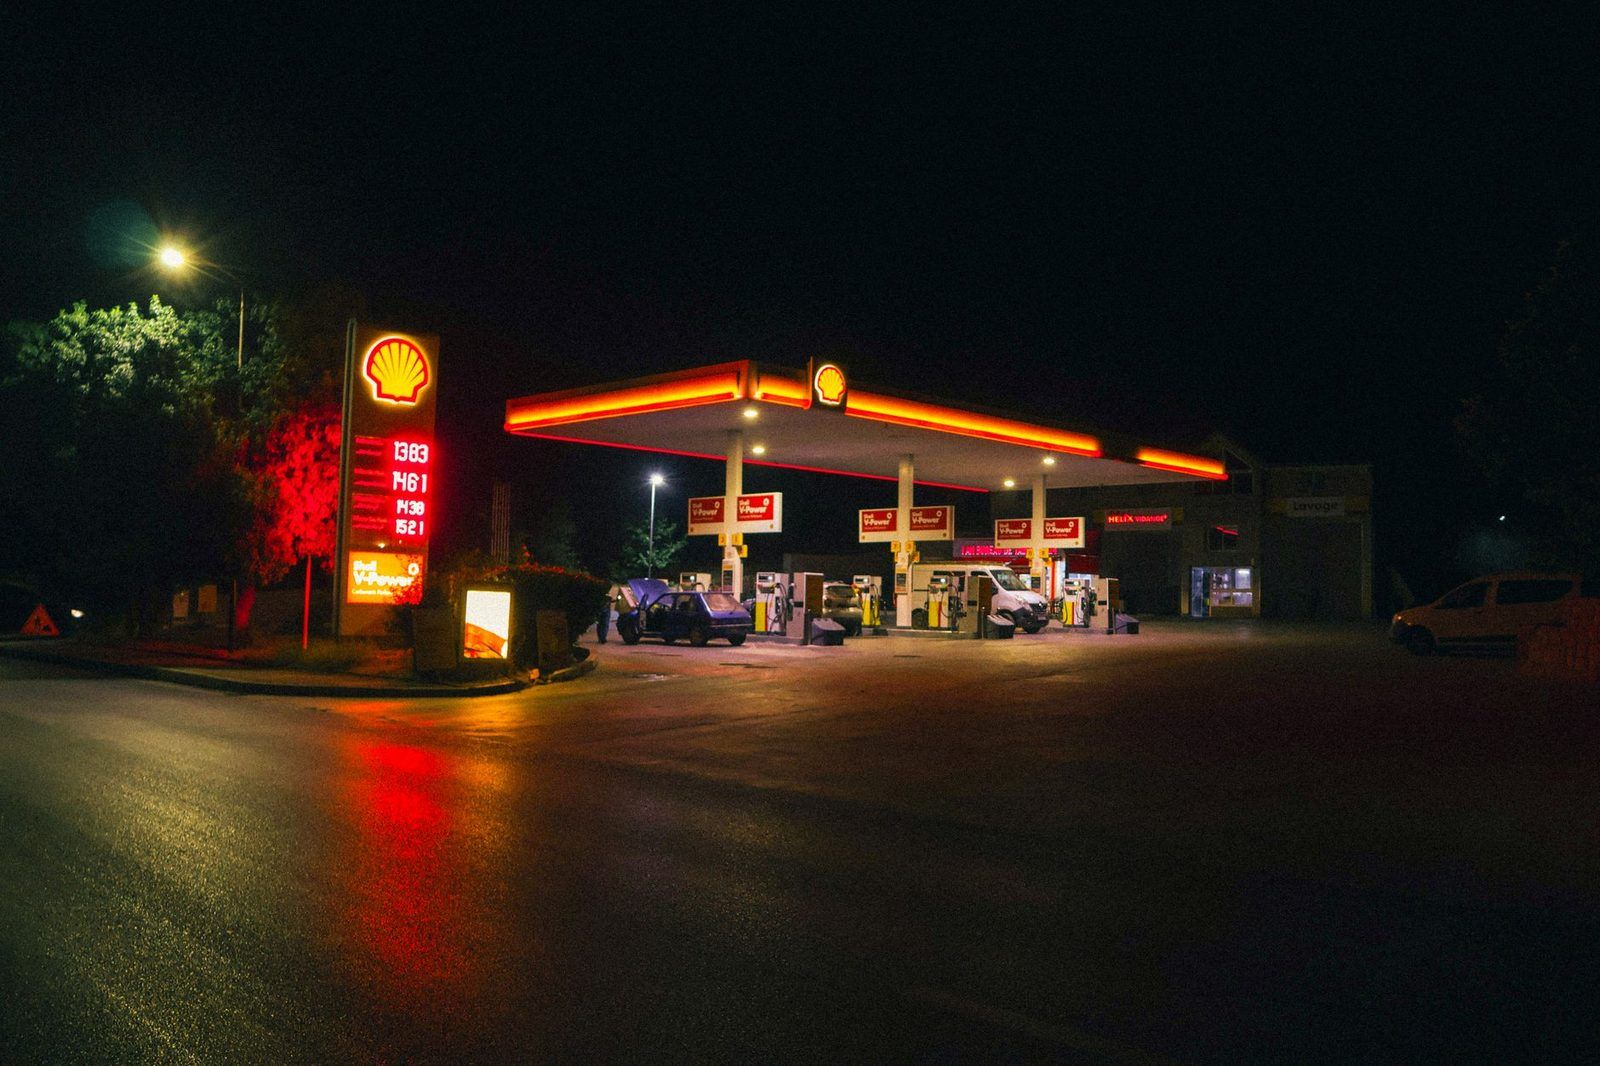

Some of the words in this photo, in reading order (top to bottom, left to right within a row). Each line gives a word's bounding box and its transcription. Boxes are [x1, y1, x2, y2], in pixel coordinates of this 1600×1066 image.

[394, 441, 429, 464] 1383
[393, 471, 427, 493] 1461
[739, 506, 767, 514] V-Power
[395, 518, 424, 536] 1521
[1108, 515, 1134, 523] HELIX
[353, 570, 415, 587] V-Power
